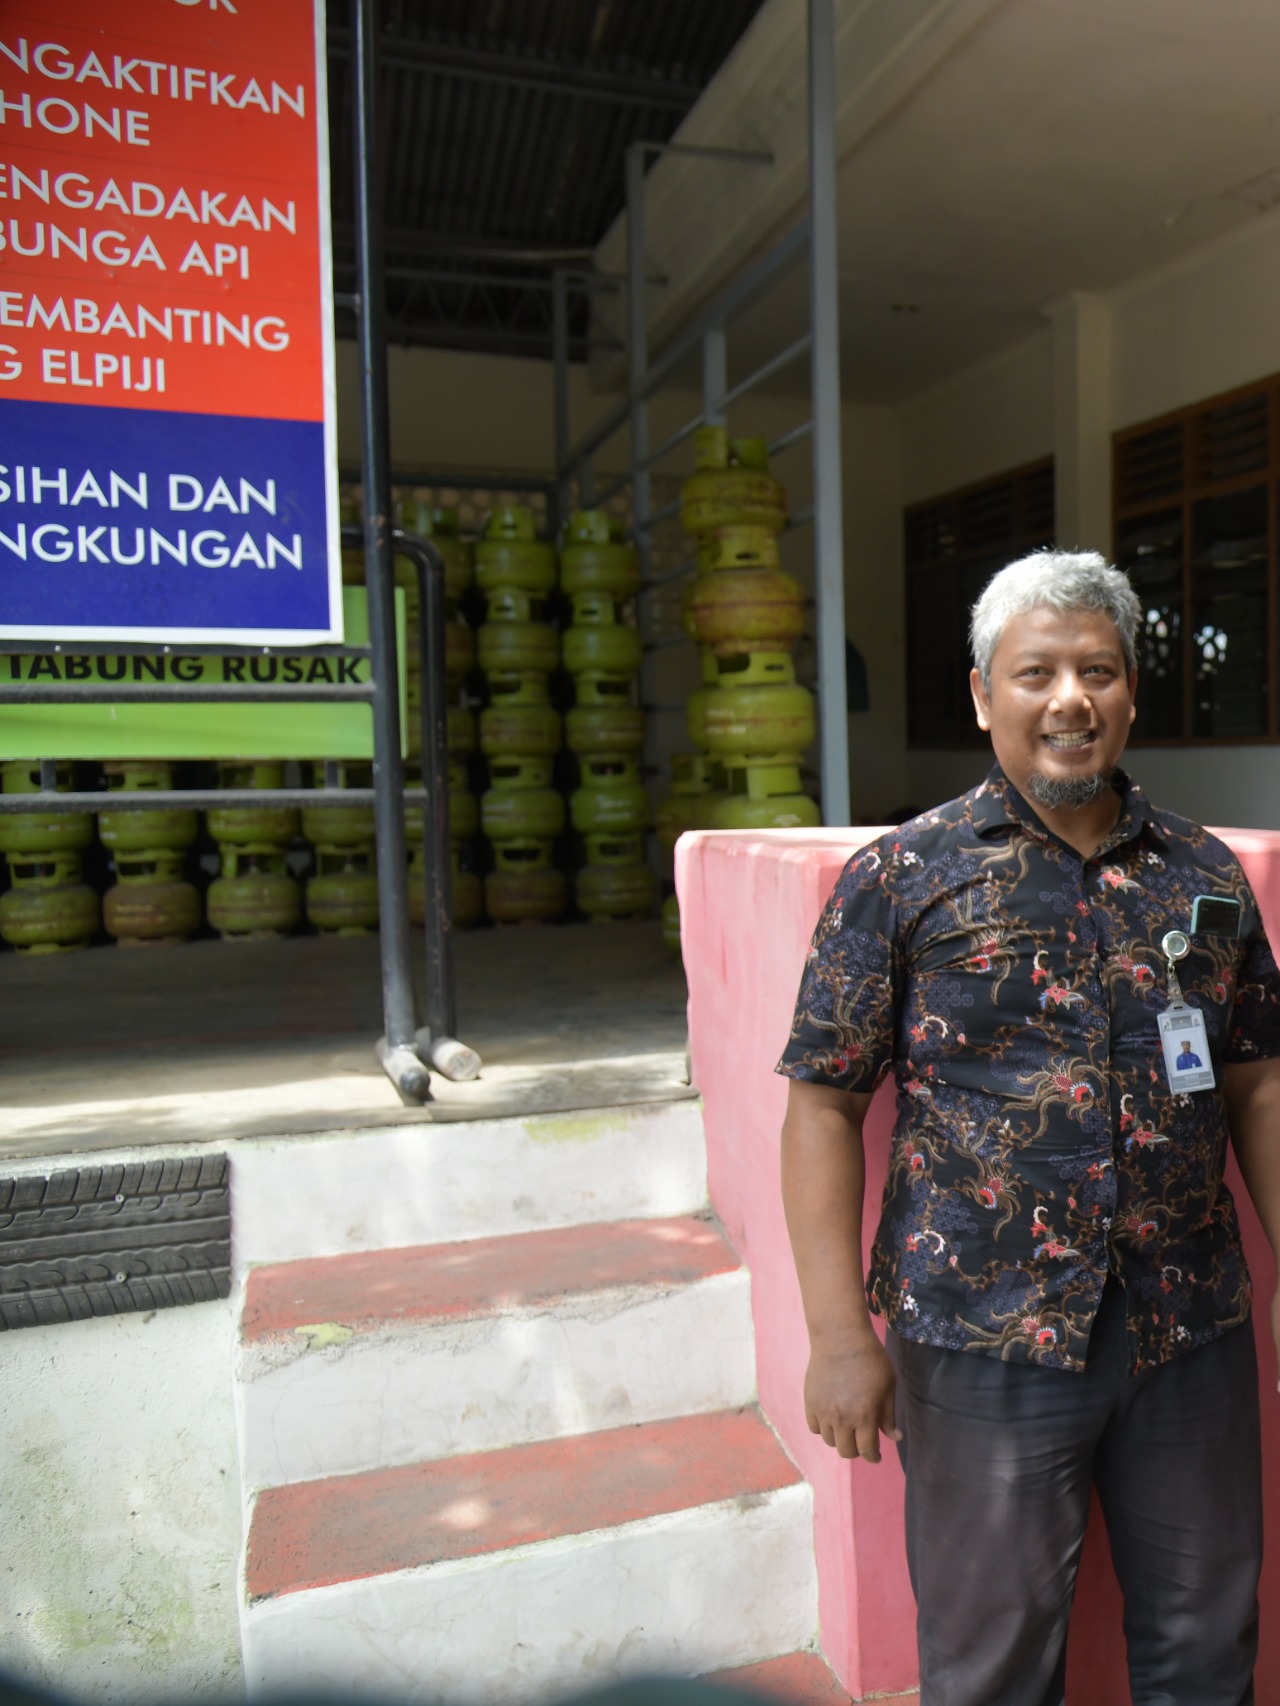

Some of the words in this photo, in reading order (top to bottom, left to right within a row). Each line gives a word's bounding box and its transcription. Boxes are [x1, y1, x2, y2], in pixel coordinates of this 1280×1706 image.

[0, 38, 305, 119] NGAKTIFKAN
[0, 89, 150, 147] HONE
[0, 163, 297, 235] NGADAKAN
[0, 218, 167, 271] UNGA
[179, 239, 250, 280] API
[0, 290, 291, 353] EMBANTING
[42, 348, 166, 393] ELPIJI
[168, 473, 277, 517] DAN
[0, 522, 303, 571] NGKUNGAN
[3, 654, 205, 682] TABUNG
[222, 655, 362, 684] RUSAK
